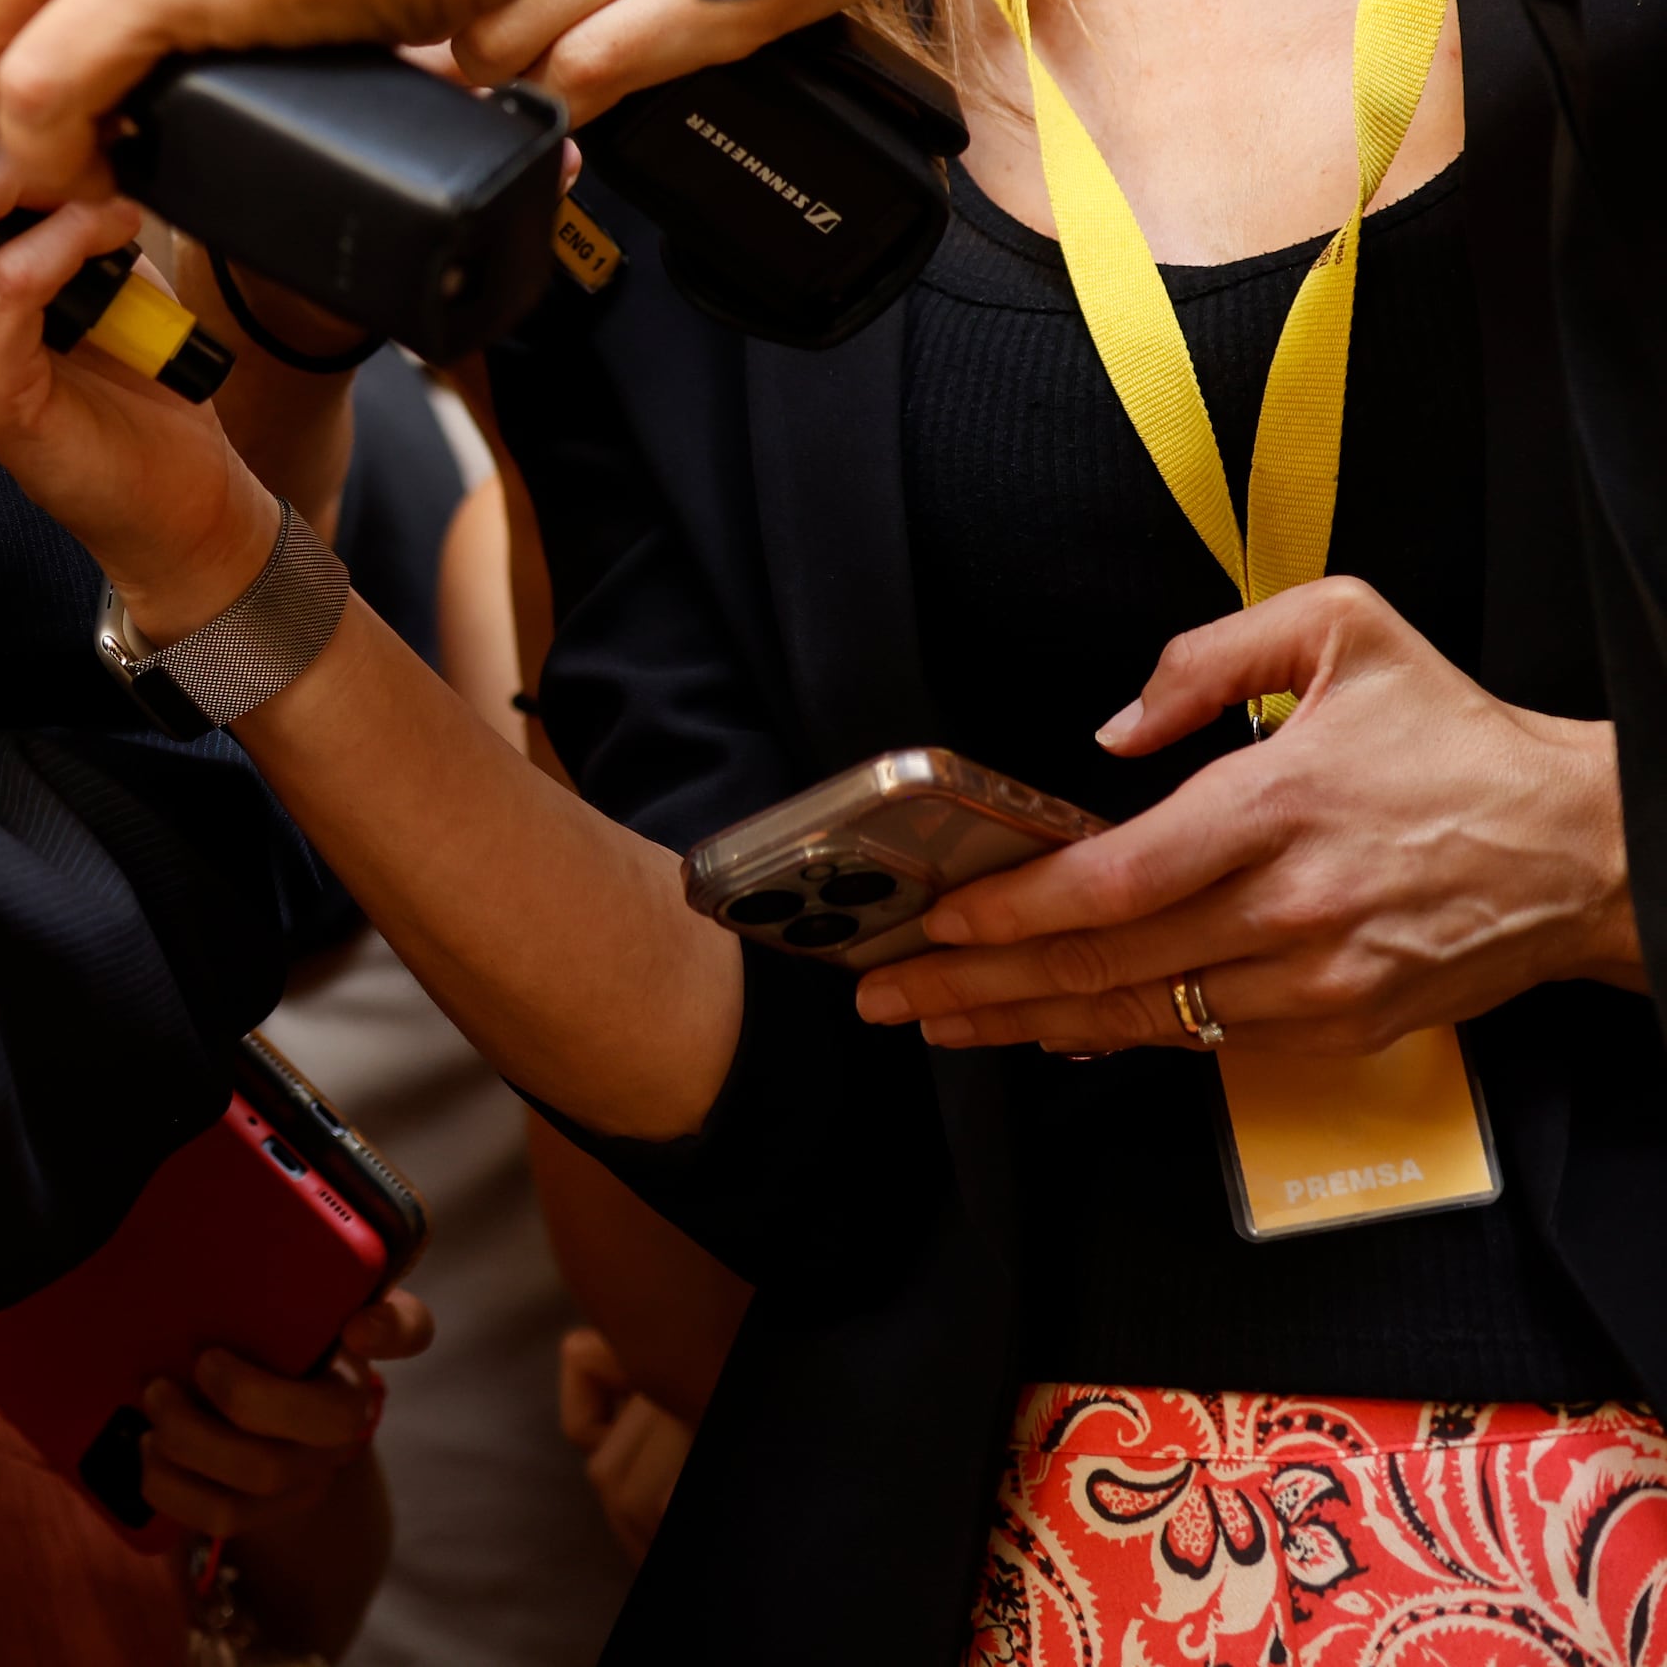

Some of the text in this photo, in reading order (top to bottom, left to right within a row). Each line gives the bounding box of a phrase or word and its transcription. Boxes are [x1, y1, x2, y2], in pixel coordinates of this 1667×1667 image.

[685, 113, 811, 210] SENNHEISER
[558, 221, 607, 272] ENG 1
[1284, 1158, 1425, 1205] PREMSA
